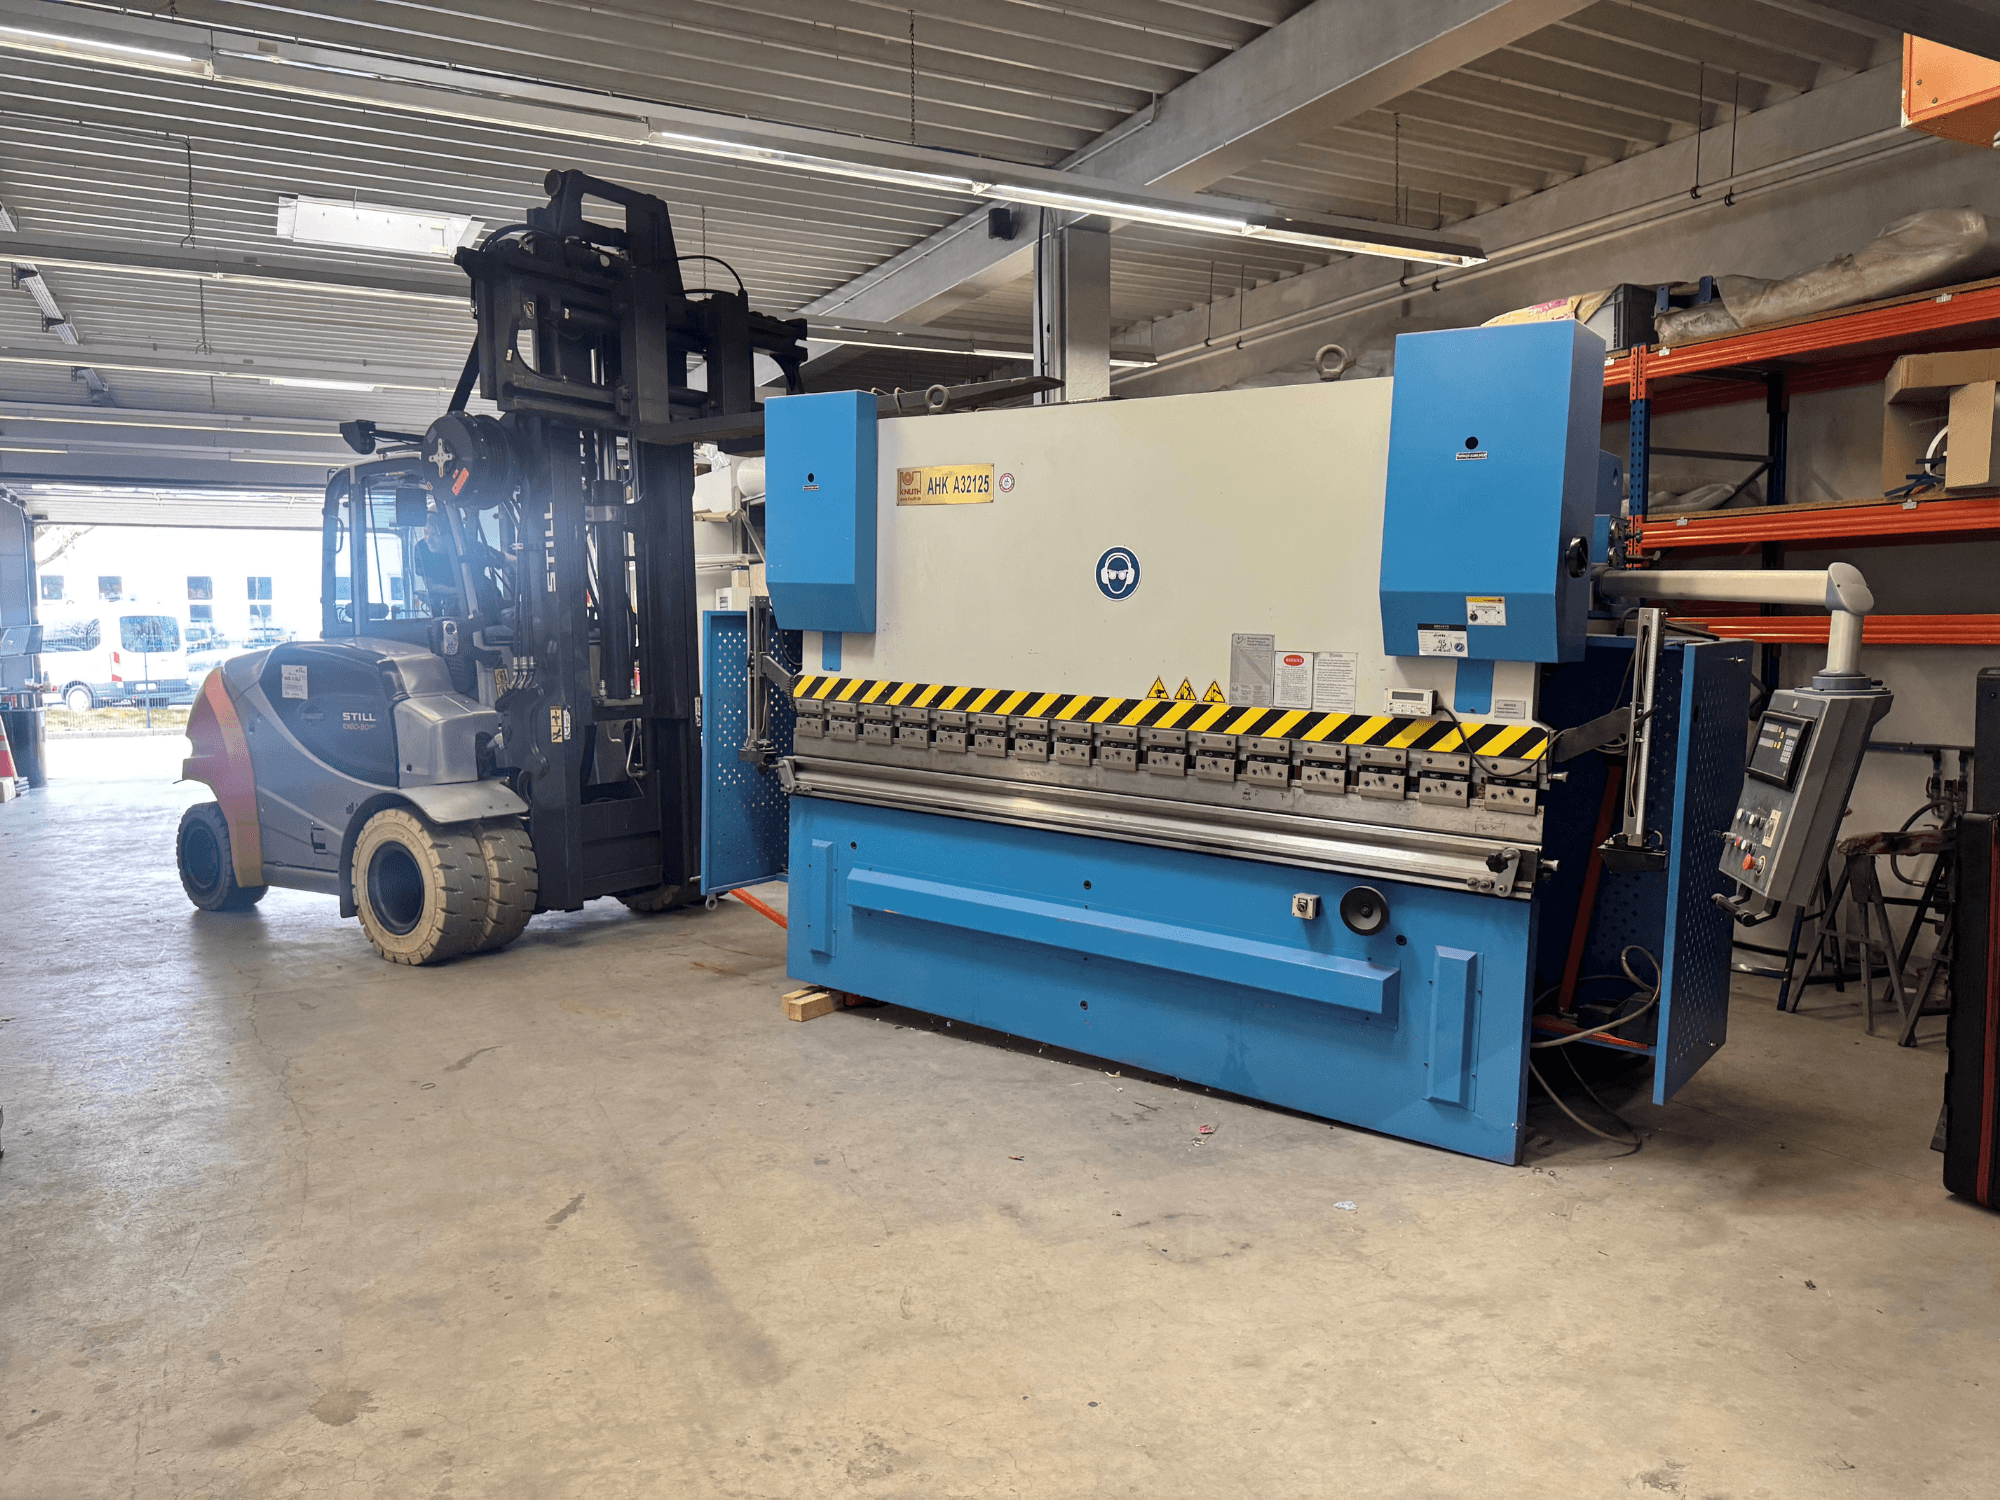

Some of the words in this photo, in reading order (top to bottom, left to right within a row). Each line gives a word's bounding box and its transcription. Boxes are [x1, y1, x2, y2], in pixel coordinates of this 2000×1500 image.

[928, 477, 949, 495] AHK
[953, 475, 990, 494] A32125
[543, 502, 556, 592] STILL
[342, 712, 376, 722] STILL
